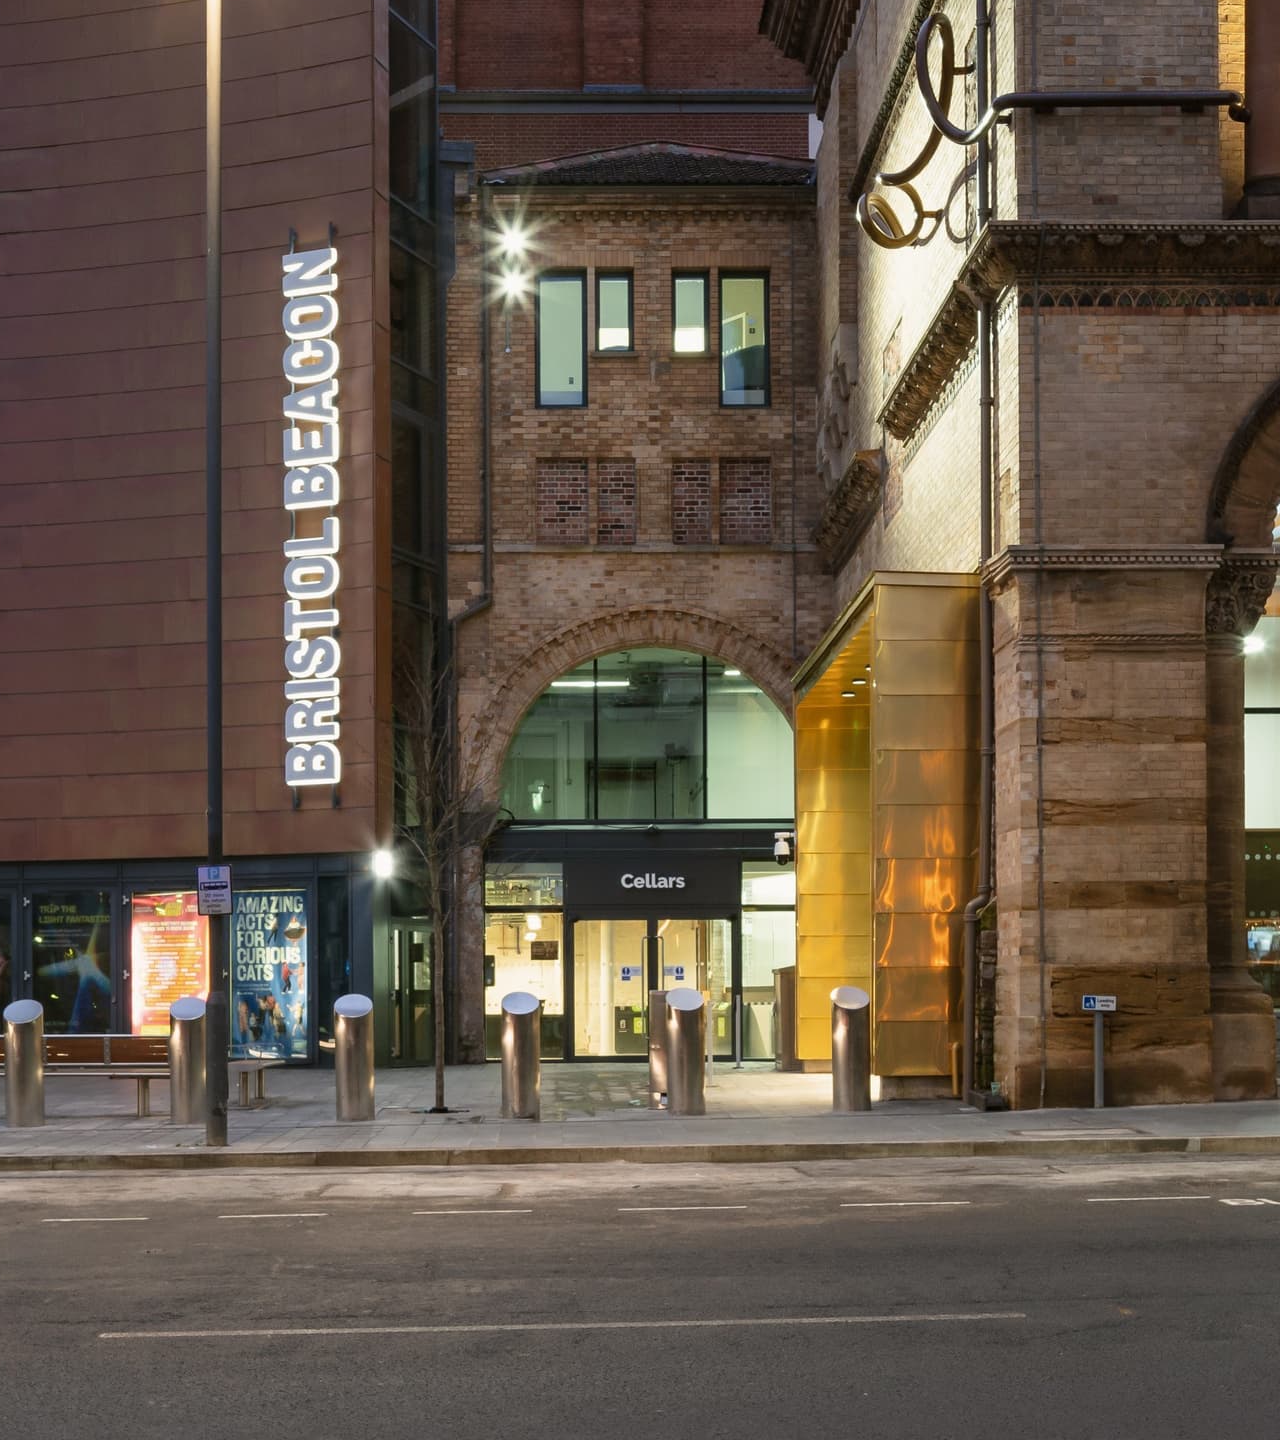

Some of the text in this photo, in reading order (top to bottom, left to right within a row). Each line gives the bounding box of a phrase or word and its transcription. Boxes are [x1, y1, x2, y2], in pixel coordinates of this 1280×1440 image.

[282, 247, 341, 787] BRISTOL BEACON
[620, 873, 686, 889] Cellars
[236, 895, 304, 913] AMAZING
[236, 913, 274, 930] ACTS
[236, 930, 265, 947] FOR
[236, 946, 302, 964] CURIOUS
[236, 964, 274, 981] CATS
